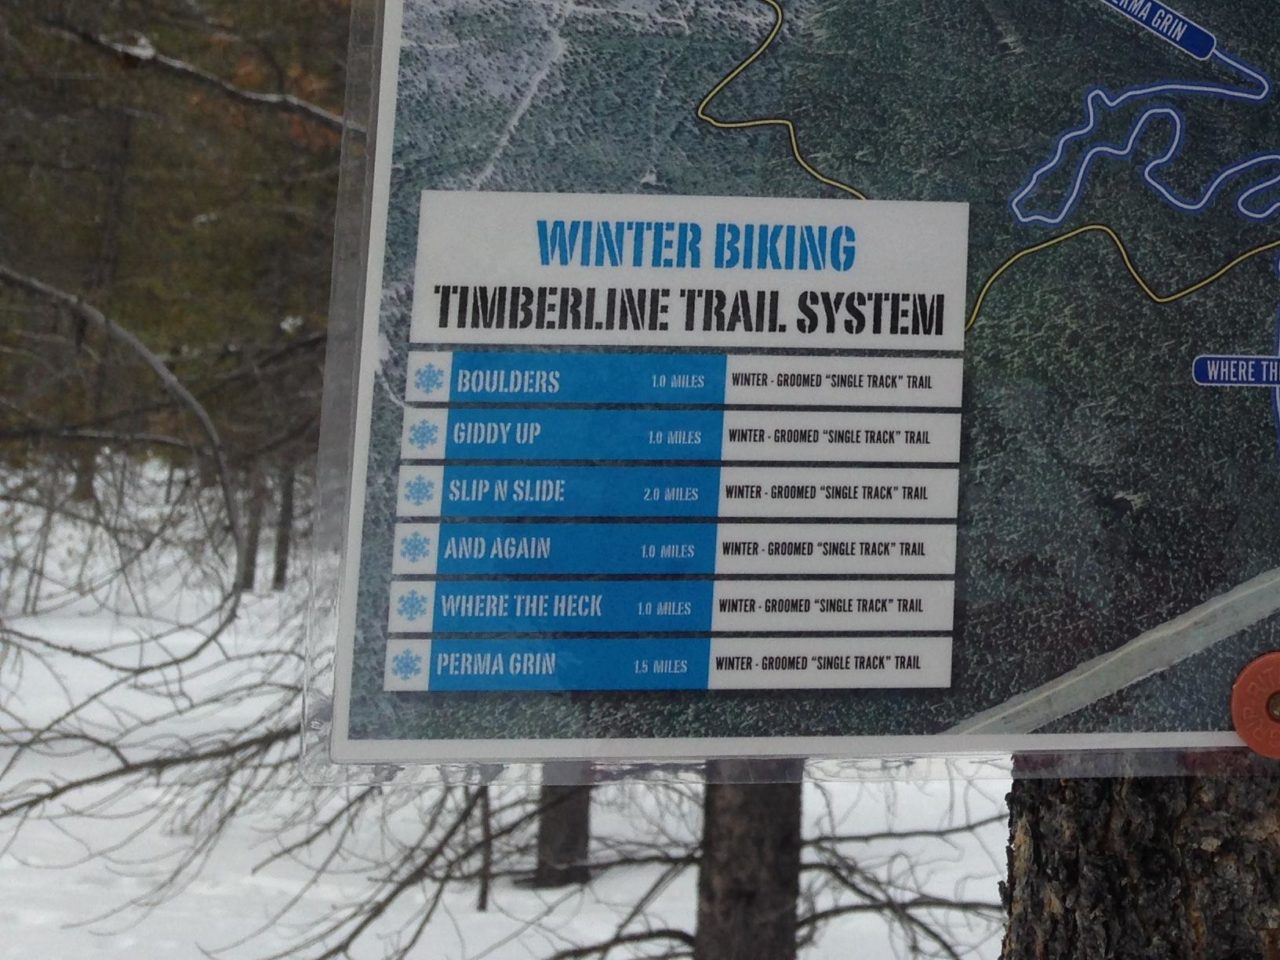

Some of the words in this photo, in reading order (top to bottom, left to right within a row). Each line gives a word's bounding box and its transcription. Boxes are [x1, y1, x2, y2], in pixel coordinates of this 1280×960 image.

[1151, 8, 1188, 43] GRIN
[537, 220, 701, 268] WINTER
[714, 223, 856, 273] BIKING
[434, 284, 671, 331] TIMBERLINE
[679, 288, 787, 334] TRAIL
[796, 290, 945, 337] SYSTEM
[1207, 360, 1255, 382] WHERE
[457, 369, 560, 393] BOULDERS
[652, 374, 666, 388] 1.0
[670, 374, 705, 388] MILES
[732, 373, 768, 387] WINTER
[777, 374, 822, 388] GROOMED
[906, 376, 932, 390] TRAIL
[453, 422, 511, 444] GIDDY
[516, 422, 541, 444] UP
[649, 431, 663, 444] 1.0
[667, 431, 702, 444] MILES
[729, 429, 765, 443] WINTER
[774, 430, 819, 444] GROOMED
[904, 430, 930, 444] TRAIL
[449, 479, 490, 502] SLIP
[494, 479, 507, 501] N
[512, 479, 565, 502] SLIDE
[643, 487, 660, 501] 2.0
[664, 487, 699, 501] MILES
[726, 485, 762, 499] WINTER
[771, 486, 816, 500] GROOMED
[902, 486, 928, 500] TRAIL
[444, 537, 486, 559] AND
[490, 537, 550, 559] AGAIN
[641, 544, 656, 558] 1.0
[660, 544, 695, 558] MILES
[722, 542, 759, 556] WINTER
[768, 542, 813, 556] GROOMED
[899, 542, 925, 556] TRAIL
[441, 594, 509, 617] WHERE
[513, 594, 549, 617] THE
[553, 594, 603, 617] HECK
[638, 602, 652, 615] 1.0
[656, 602, 692, 615] MILES
[719, 599, 756, 613] WINTER
[765, 599, 810, 613] GROOMED
[897, 598, 923, 612] TRAIL
[437, 653, 504, 675] PERMA
[509, 653, 556, 676] GRIN
[634, 659, 648, 673] 1.5
[653, 659, 688, 673] MILES
[716, 656, 752, 670] WINTER
[761, 656, 807, 670] GROOMED
[894, 655, 921, 669] TRAIL
